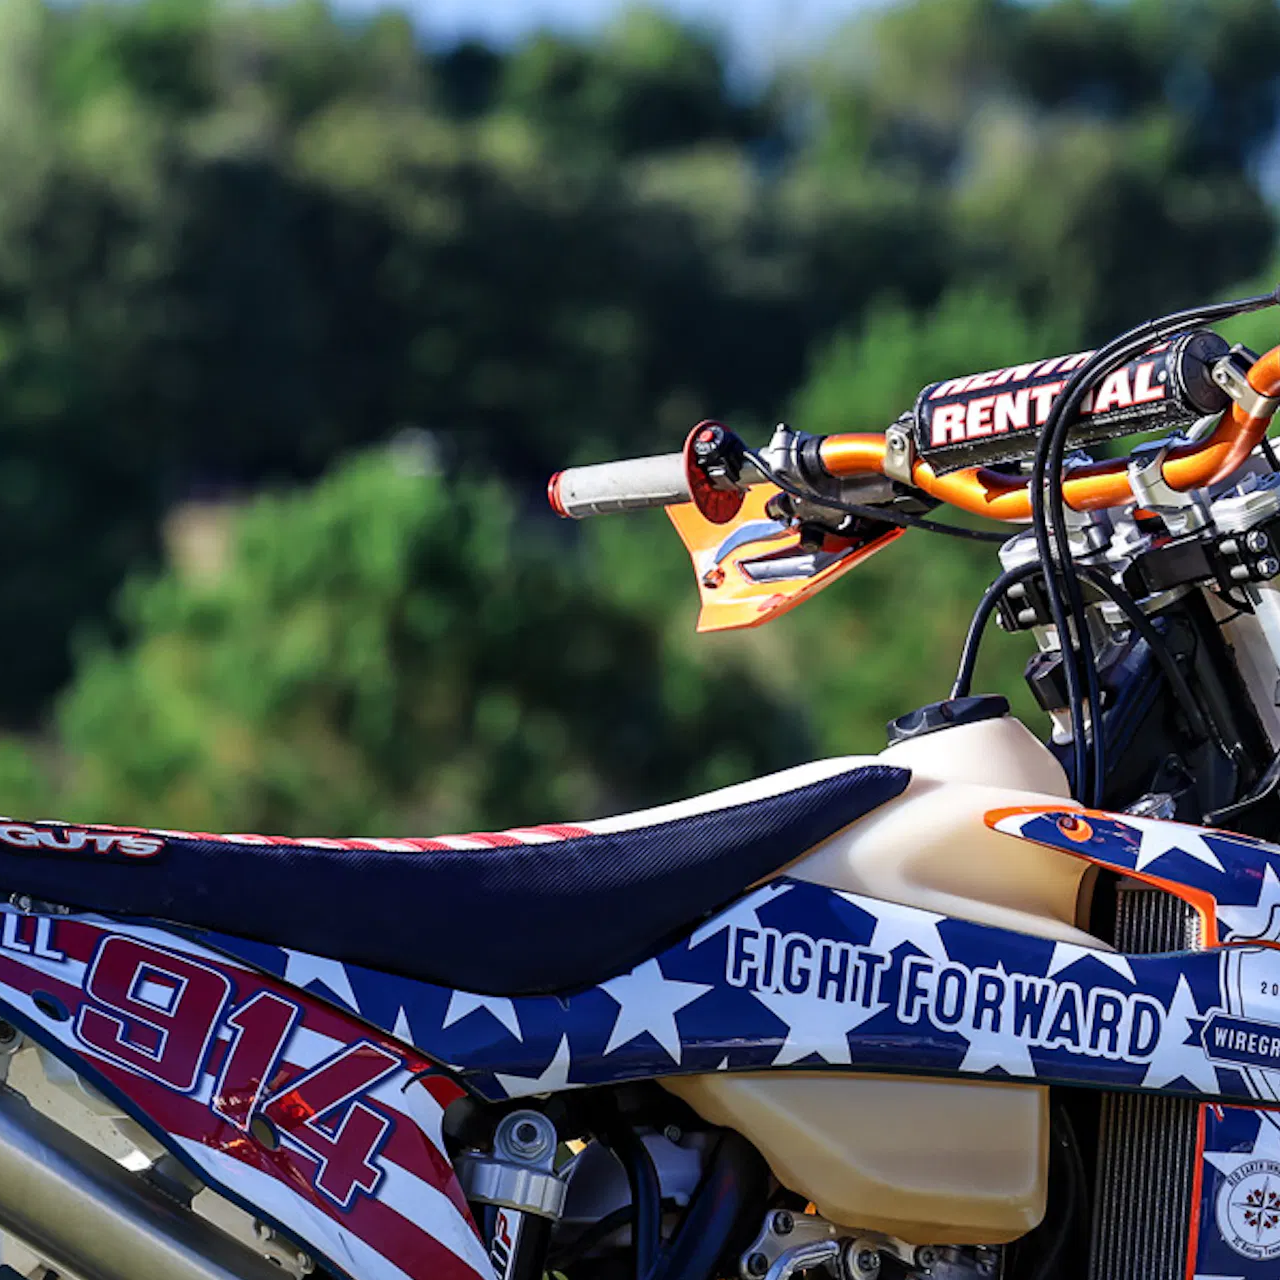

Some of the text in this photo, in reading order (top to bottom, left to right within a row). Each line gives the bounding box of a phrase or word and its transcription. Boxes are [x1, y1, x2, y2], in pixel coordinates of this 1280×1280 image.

[930, 360, 1167, 448] RENTAL
[728, 926, 1163, 1060] FIGHT FORWARD
[1261, 981, 1279, 996] 20
[75, 933, 405, 1210] 914
